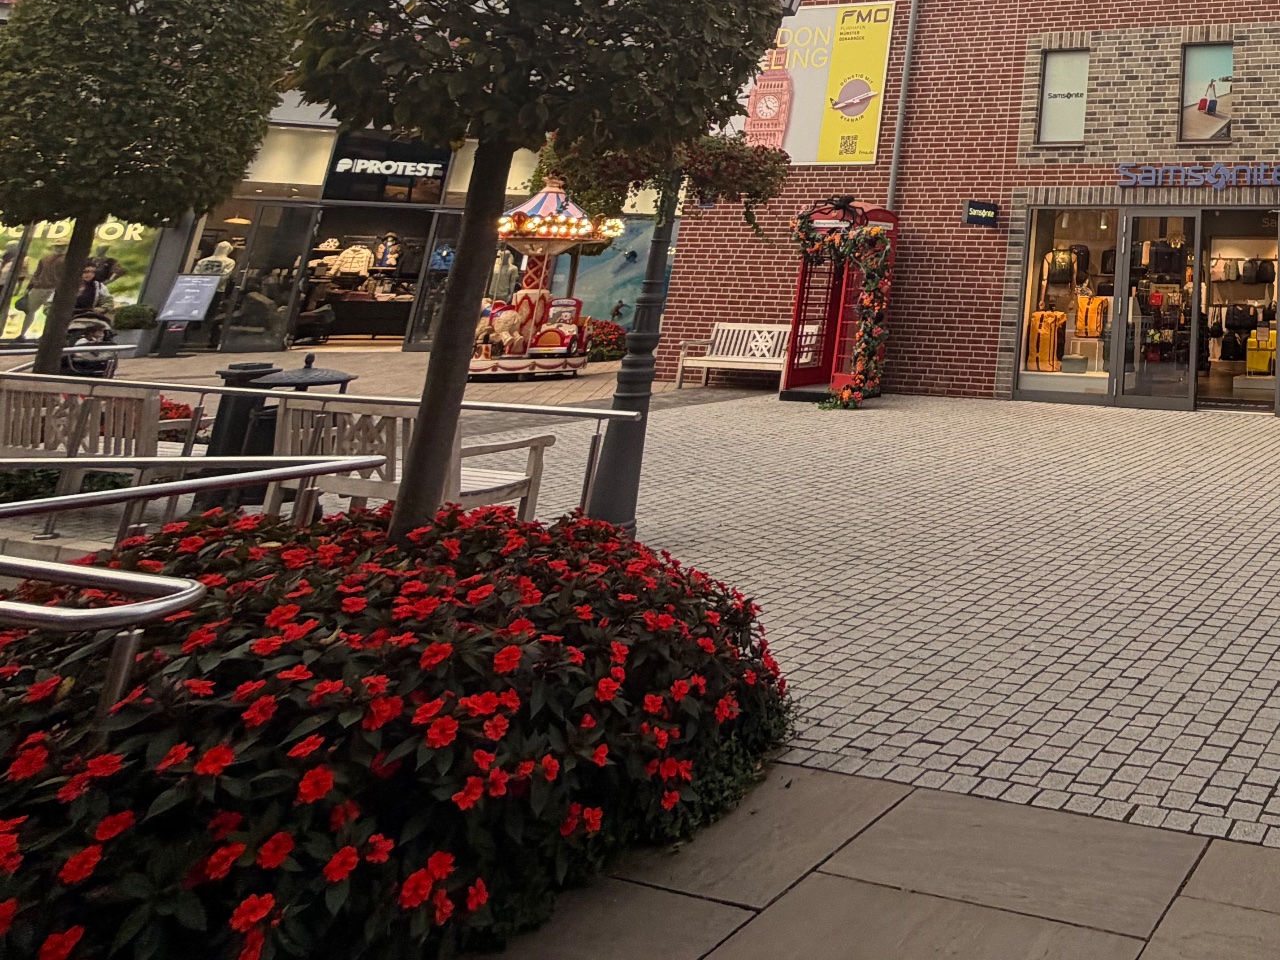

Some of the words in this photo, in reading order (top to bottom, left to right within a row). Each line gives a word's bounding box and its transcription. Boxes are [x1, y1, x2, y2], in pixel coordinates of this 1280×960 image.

[841, 8, 890, 24] FMO
[1047, 91, 1085, 100] Samsonite
[840, 114, 864, 123] RYANAIR
[354, 159, 443, 177] PROTEST
[969, 207, 995, 218] Samsonite
